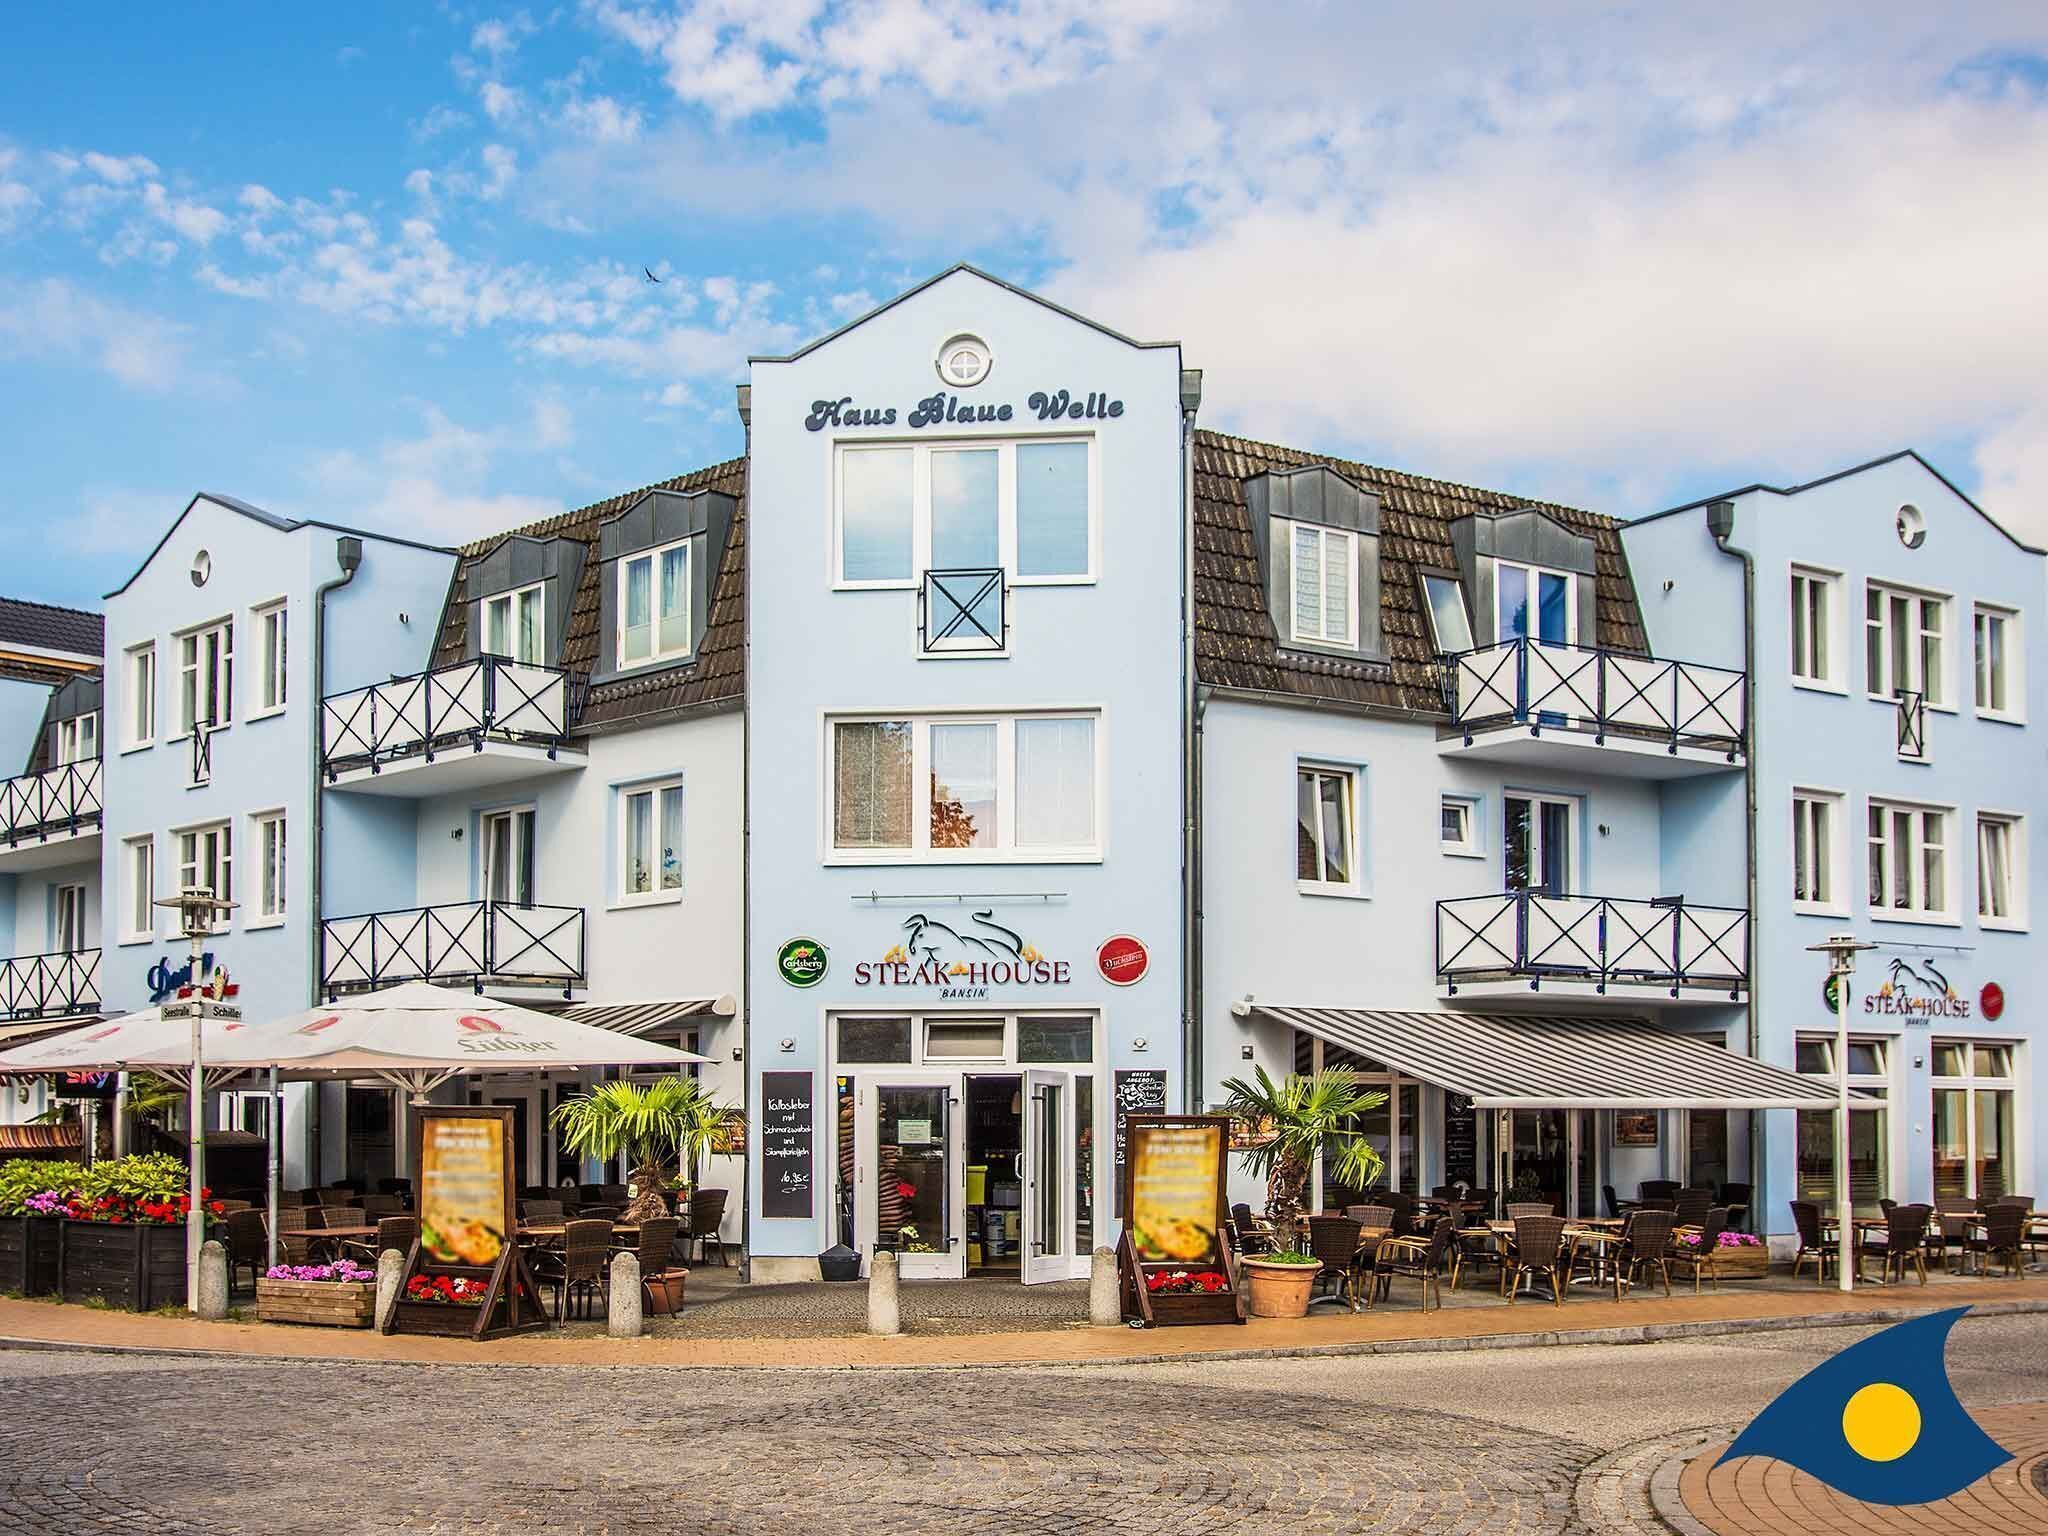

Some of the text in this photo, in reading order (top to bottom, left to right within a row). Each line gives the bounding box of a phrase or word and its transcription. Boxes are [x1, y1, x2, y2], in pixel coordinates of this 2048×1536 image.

[805, 389, 1125, 431] Haus Blaue Welle
[783, 957, 822, 970] Carlsberg
[854, 961, 1072, 985] STEAK HOUSE
[941, 988, 986, 999] BANSIN
[1864, 994, 1914, 1016] STEAK
[1922, 997, 1971, 1019] HOUSE
[783, 1136, 795, 1145] und
